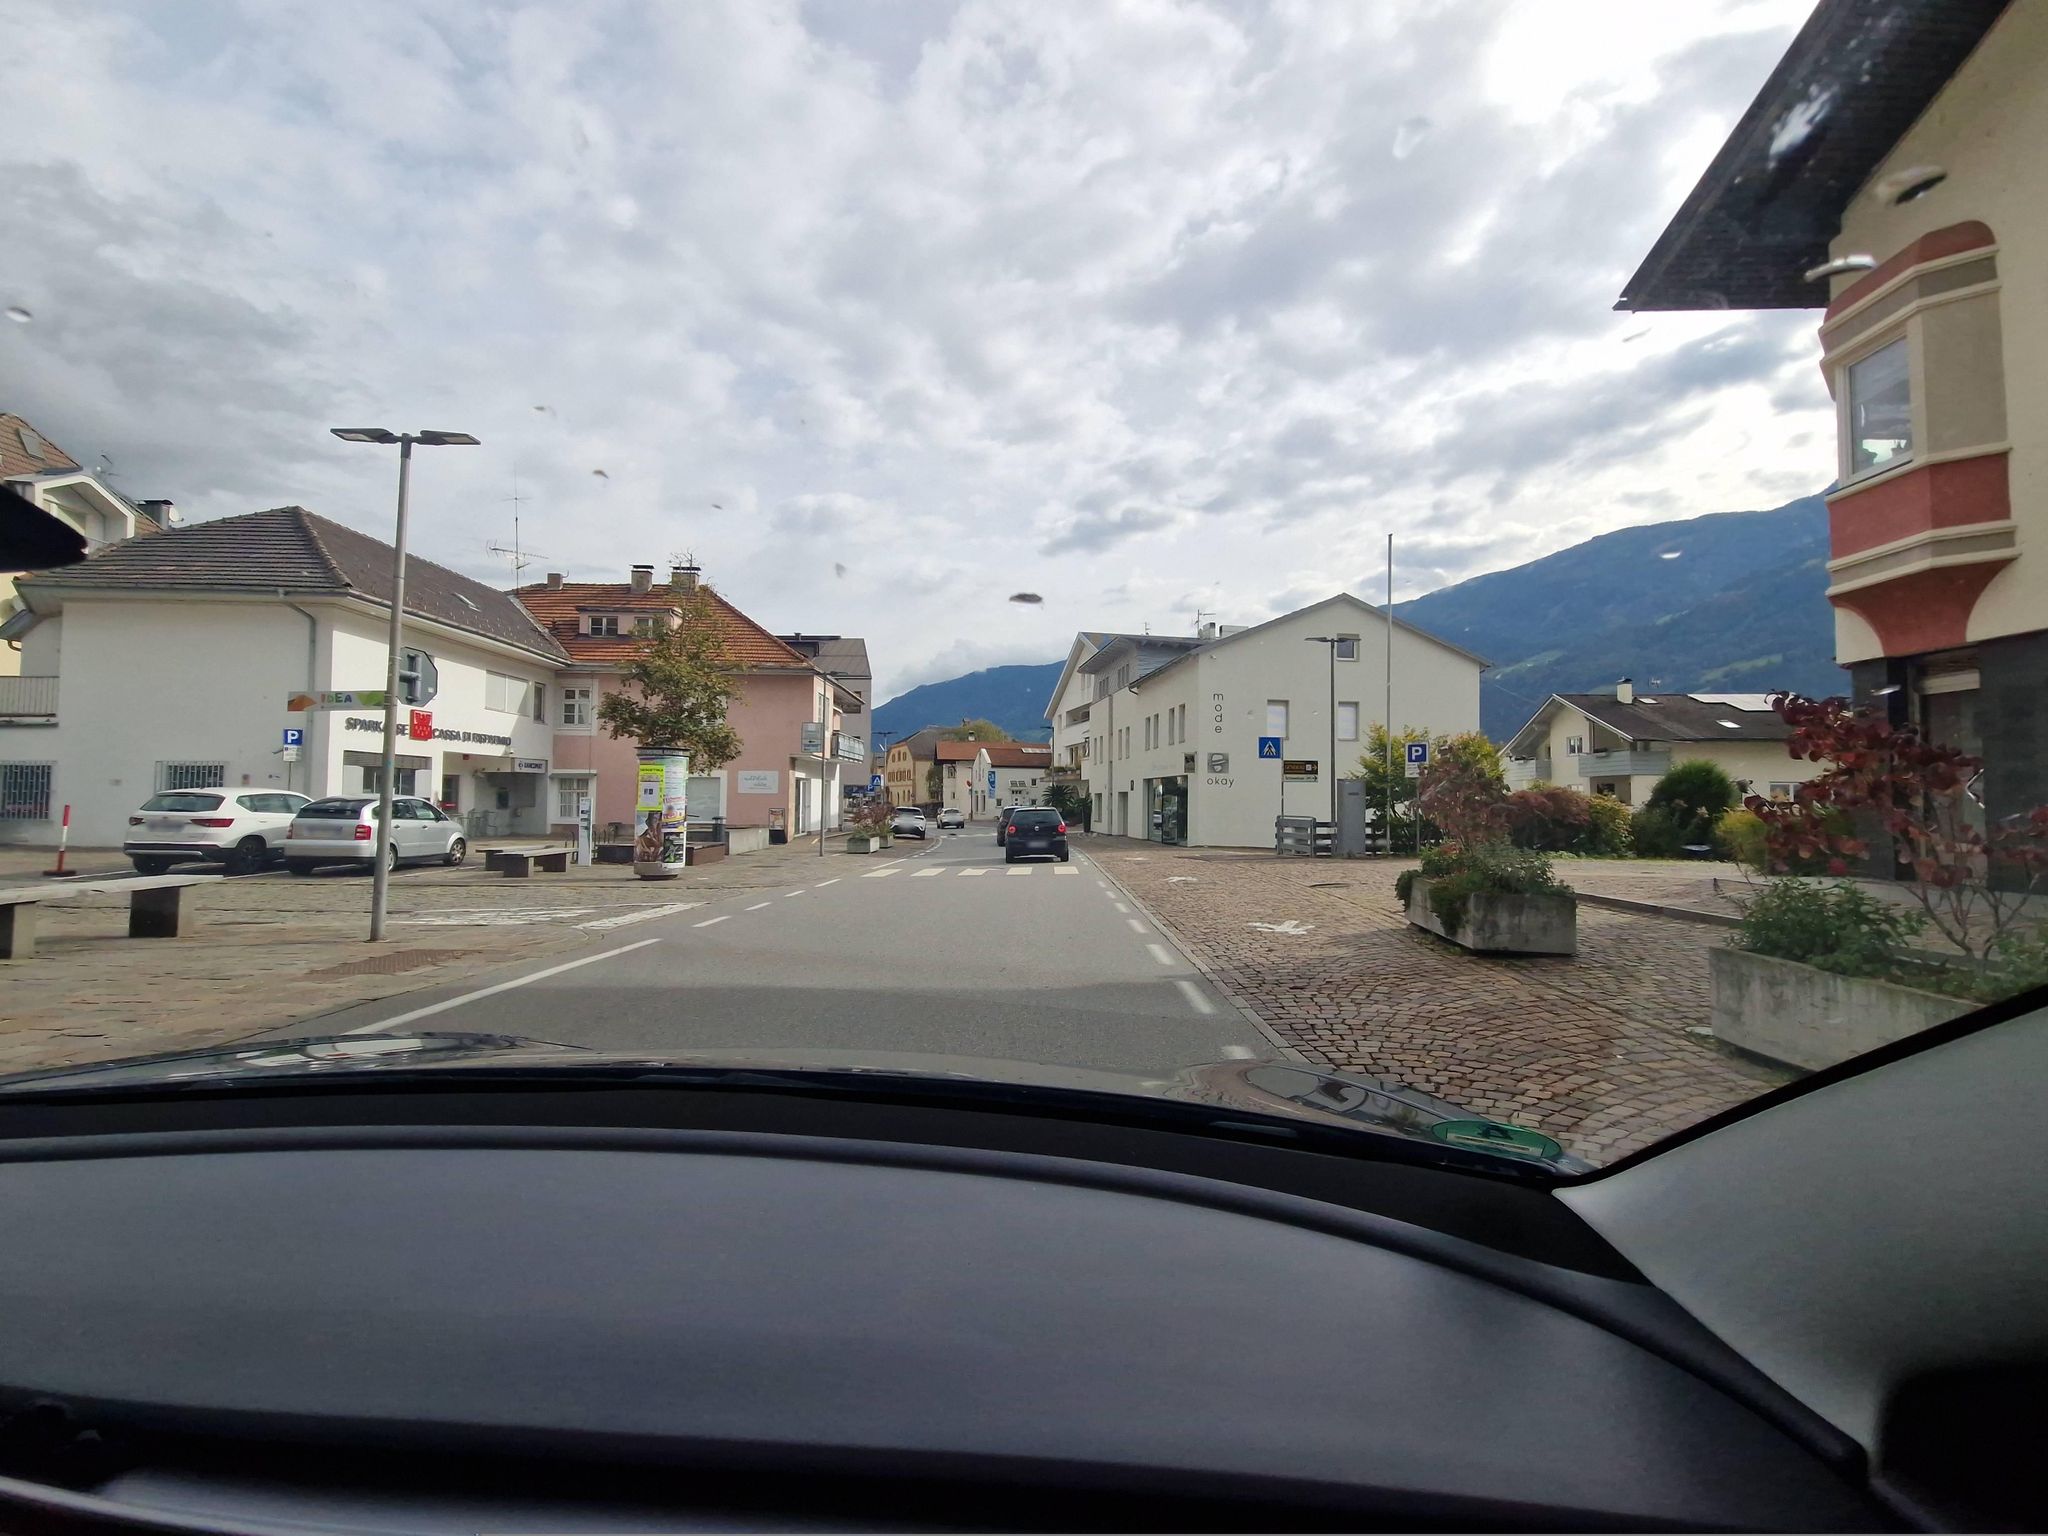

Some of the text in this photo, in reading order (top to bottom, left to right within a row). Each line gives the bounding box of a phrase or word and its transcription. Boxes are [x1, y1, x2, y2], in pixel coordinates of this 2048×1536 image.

[1213, 693, 1224, 734] mode
[344, 717, 409, 737] SPARKSE
[1206, 777, 1235, 788] okay
